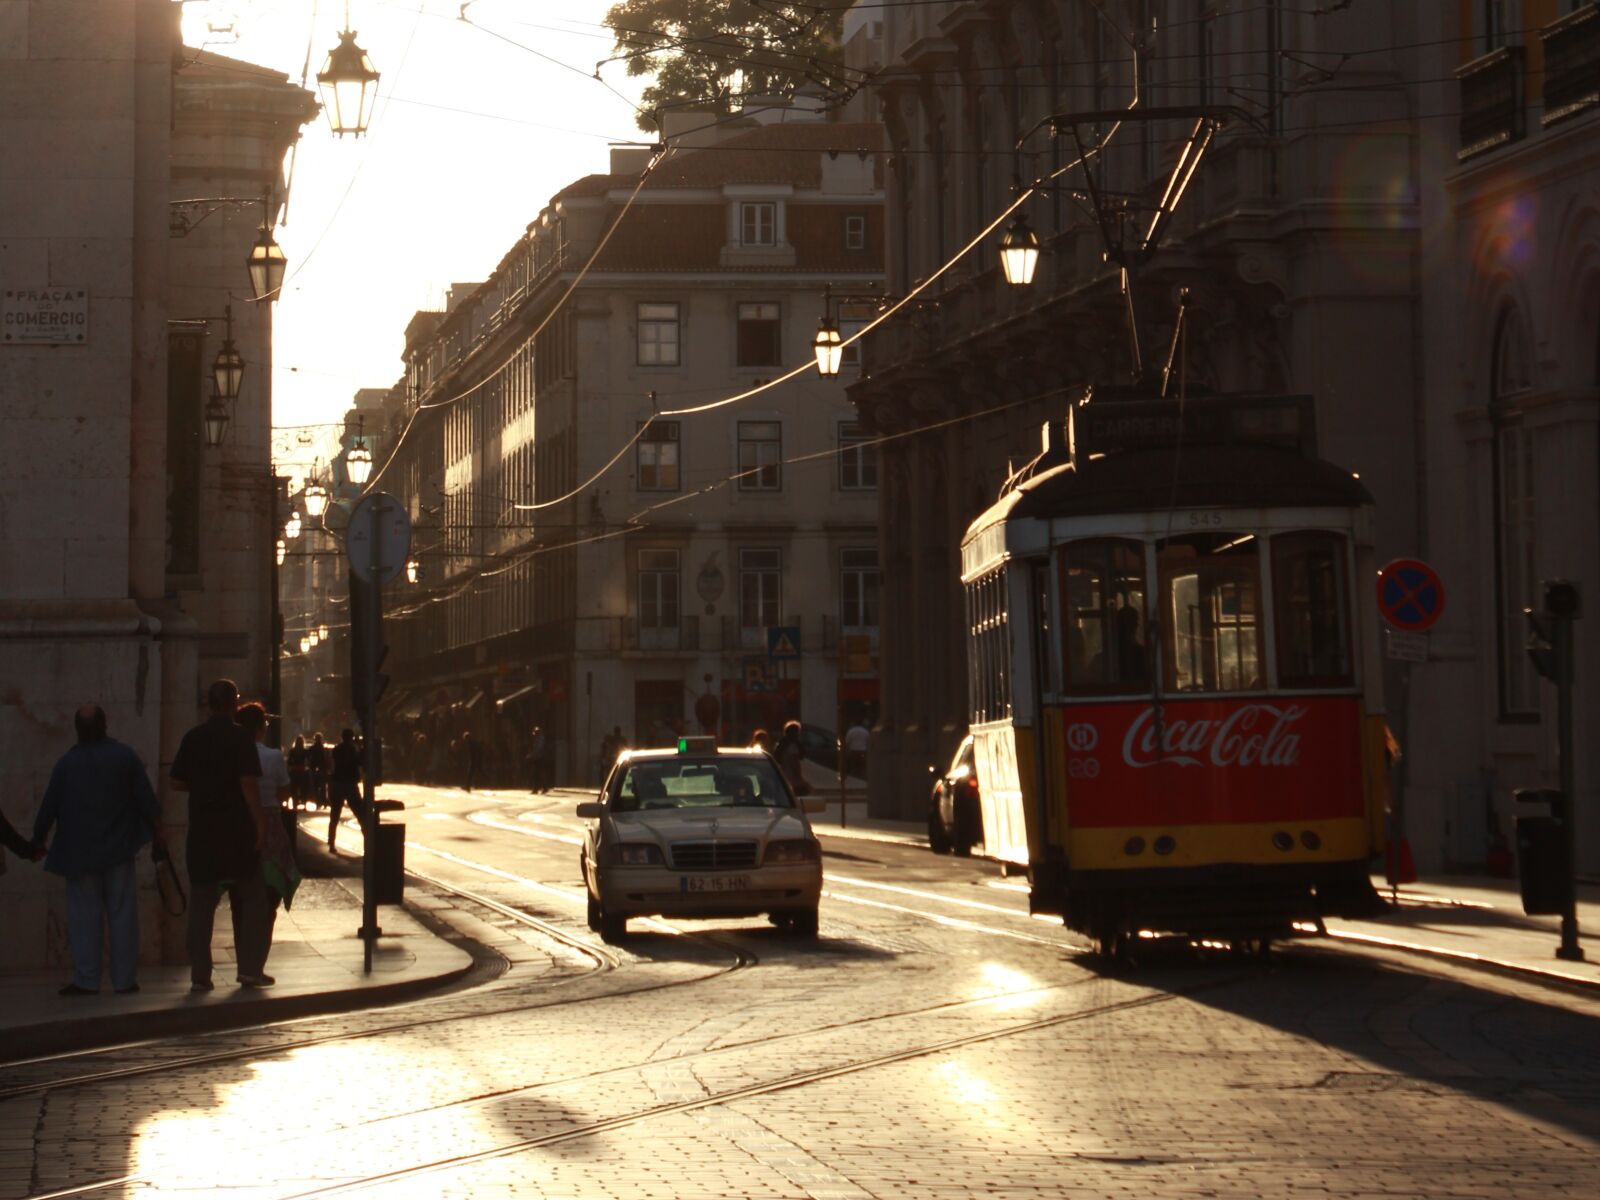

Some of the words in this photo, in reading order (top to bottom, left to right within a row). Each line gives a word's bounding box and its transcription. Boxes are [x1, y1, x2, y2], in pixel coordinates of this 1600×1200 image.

[17, 291, 74, 304] PRAÇA
[6, 311, 85, 325] COMERCIO
[1122, 704, 1305, 768] Coca-Cola
